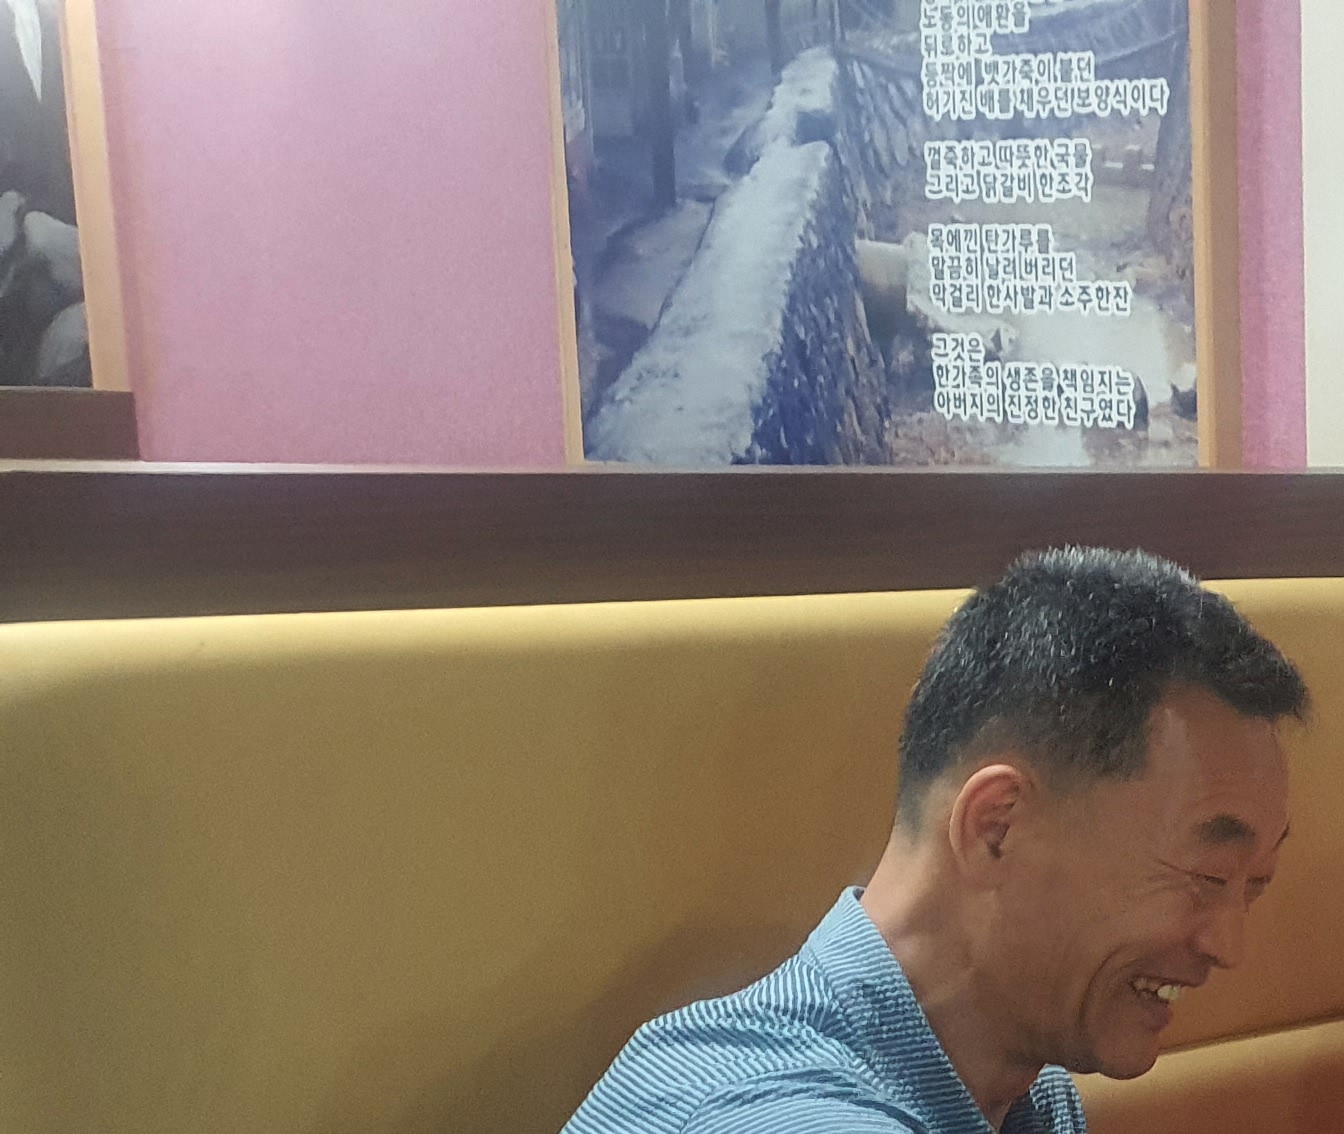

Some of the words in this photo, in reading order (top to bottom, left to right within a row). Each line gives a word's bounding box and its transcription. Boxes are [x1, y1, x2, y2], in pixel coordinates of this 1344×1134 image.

[922, 5, 971, 32] 노동의
[977, 2, 1027, 29] 애환을
[925, 61, 972, 88] 등짝에
[984, 59, 1051, 86] 뱃가죽이
[927, 88, 973, 114] 허기진
[980, 88, 1011, 114] 배를
[1019, 86, 1068, 113] 채우던
[1076, 84, 1166, 113] 보양식이다
[999, 143, 1049, 170] 따뜻한
[1056, 143, 1088, 169] 국물
[928, 172, 976, 198] 그리고
[983, 172, 1031, 198] 닭갈비
[1040, 172, 1088, 198] 한조각
[931, 228, 977, 253] 목에낀
[985, 228, 1050, 254] 탄가루를
[932, 256, 978, 280] 말끔히
[986, 256, 1017, 280] 날려
[1024, 254, 1075, 282] 버리던
[932, 283, 979, 308] 막걸리
[987, 284, 1053, 310] 한사발과
[1060, 285, 1129, 312] 소주한잔
[934, 337, 982, 362] 그것은
[936, 365, 1000, 390] 한가족의
[1007, 366, 1055, 392] 생존을
[1063, 368, 1131, 395] 책임지는
[938, 393, 1001, 418] 아버지의
[1008, 395, 1058, 420] 진정한
[1064, 396, 1132, 423] 친구였다
